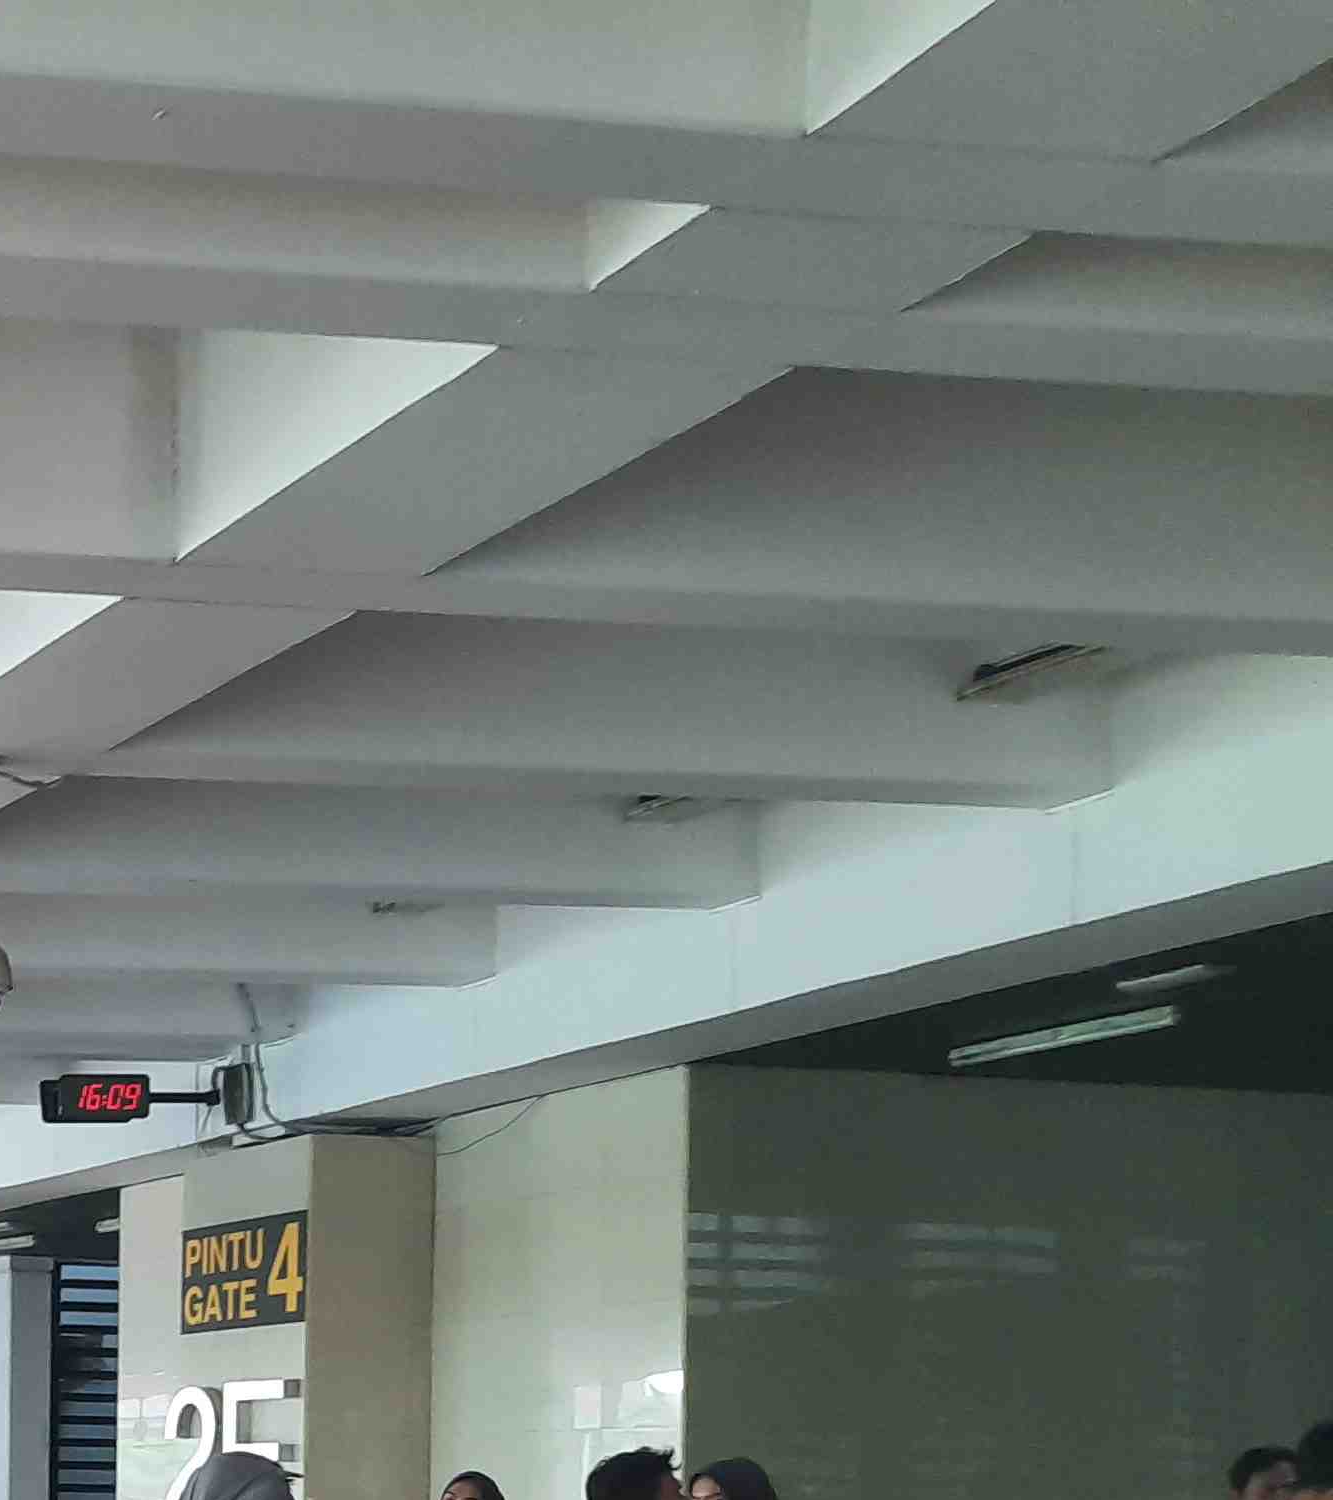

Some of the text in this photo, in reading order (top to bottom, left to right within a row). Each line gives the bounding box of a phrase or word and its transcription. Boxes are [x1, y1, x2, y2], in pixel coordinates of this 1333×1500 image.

[78, 1083, 142, 1110] 16:09
[184, 1228, 264, 1278] PINTU
[267, 1221, 304, 1312] 4
[183, 1278, 258, 1326] GATE
